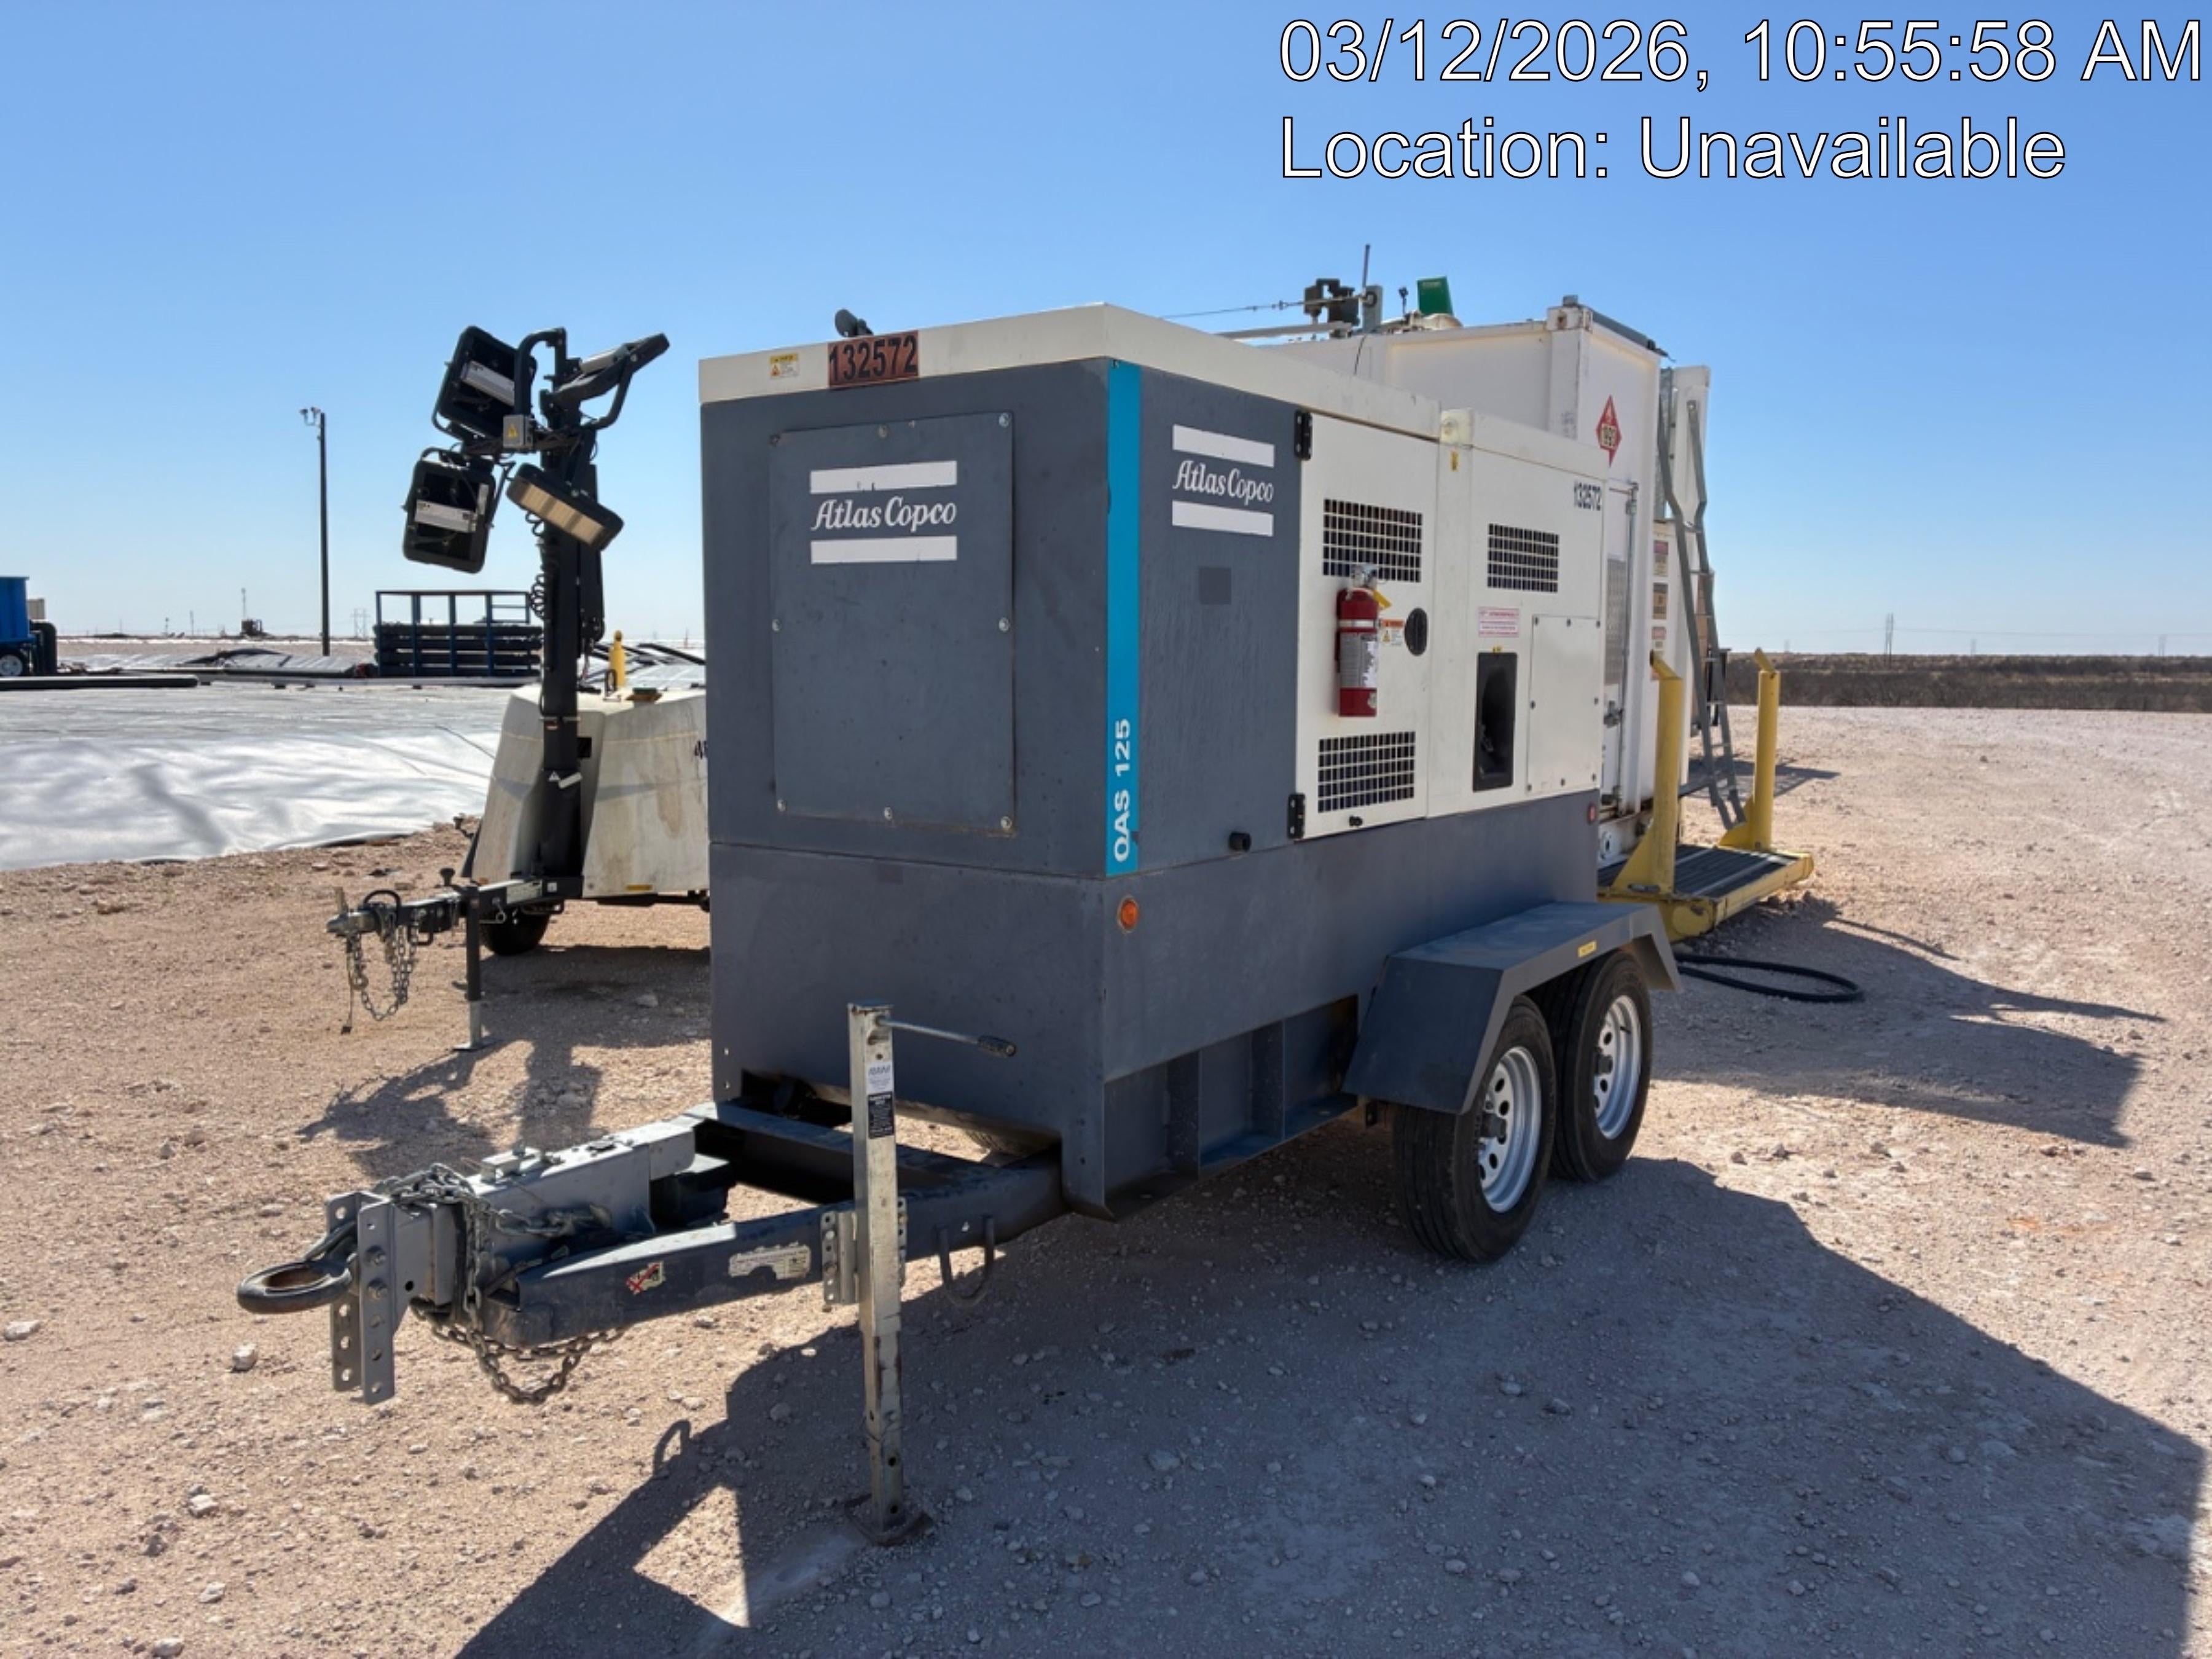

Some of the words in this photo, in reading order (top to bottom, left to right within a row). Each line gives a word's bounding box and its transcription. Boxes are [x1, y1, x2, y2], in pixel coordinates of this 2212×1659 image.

[829, 335, 917, 382] 132572
[1172, 459, 1227, 496] Atlas
[1228, 468, 1274, 506] Copco
[810, 498, 882, 531] Atlas
[884, 495, 957, 533] Copco
[1114, 718, 1131, 777] 125
